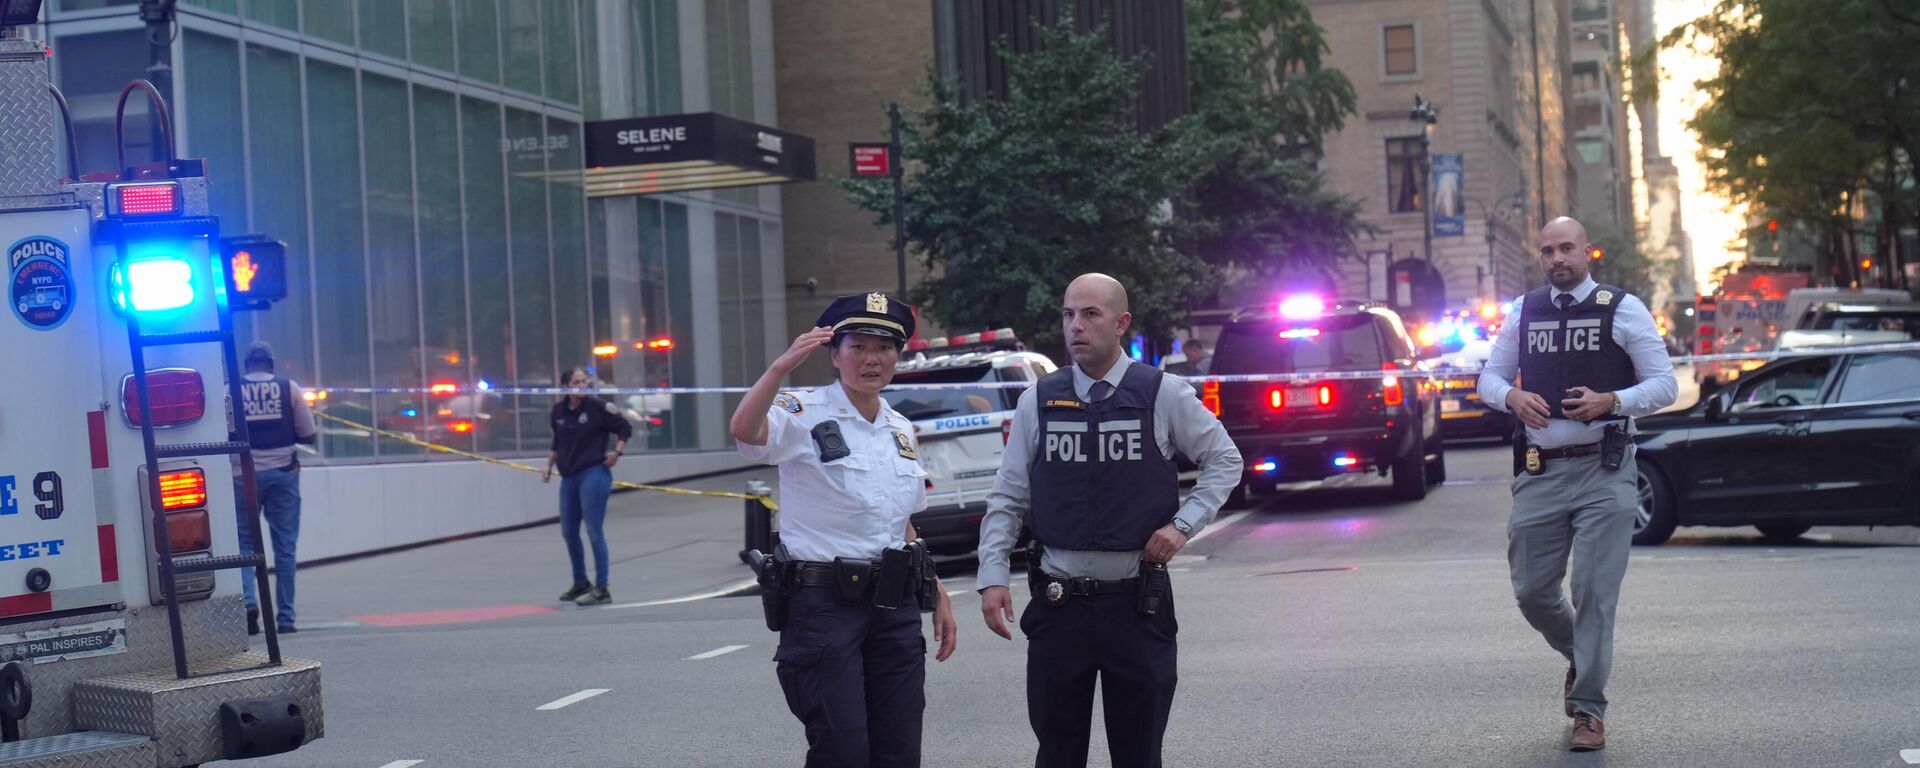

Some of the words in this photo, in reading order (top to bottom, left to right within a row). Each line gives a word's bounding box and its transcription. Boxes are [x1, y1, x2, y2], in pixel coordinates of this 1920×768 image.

[617, 127, 686, 145] SELENE
[12, 241, 65, 268] POLICE
[32, 276, 52, 285] NYPD
[1527, 328, 1601, 354] POLICE
[241, 382, 281, 401] NYPD
[936, 416, 990, 430] POLICE
[1046, 433, 1142, 462] POLICE
[33, 471, 64, 520] 9
[30, 643, 50, 653] PAL
[52, 635, 103, 650] INSPIRES
